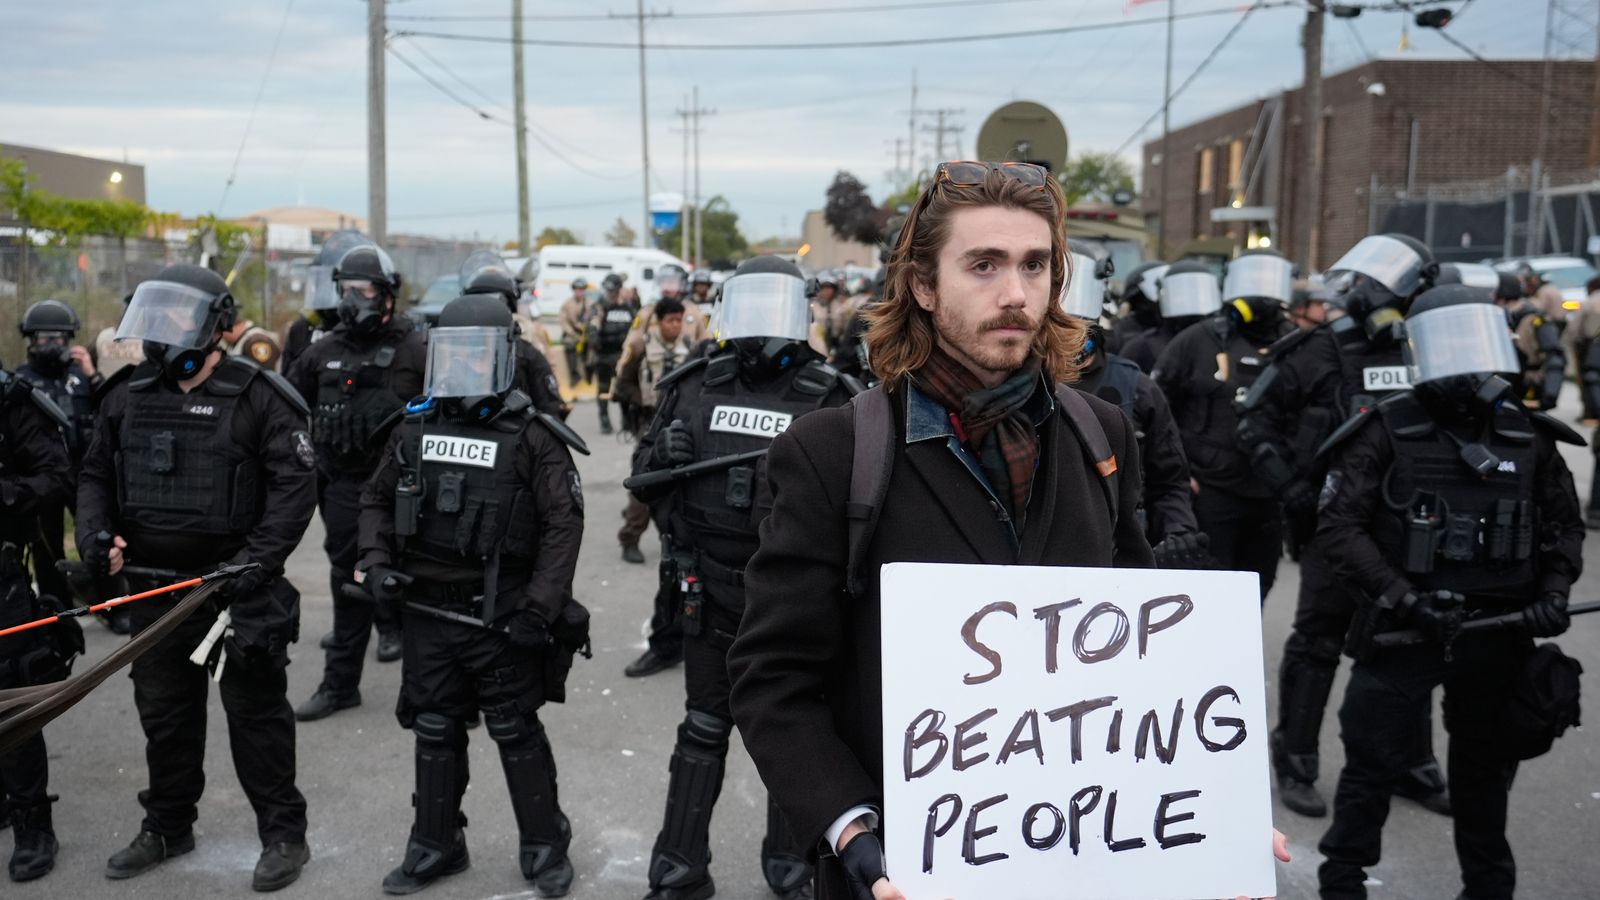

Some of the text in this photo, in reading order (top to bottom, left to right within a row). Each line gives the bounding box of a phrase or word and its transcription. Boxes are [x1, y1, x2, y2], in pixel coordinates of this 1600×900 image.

[1369, 371, 1404, 385] POL
[190, 405, 214, 415] 4240
[715, 410, 786, 433] POLICE
[424, 439, 492, 462] POLICE
[960, 593, 1194, 685] STOP
[904, 685, 1248, 782] BEATING
[922, 785, 1207, 875] PEOPLE
